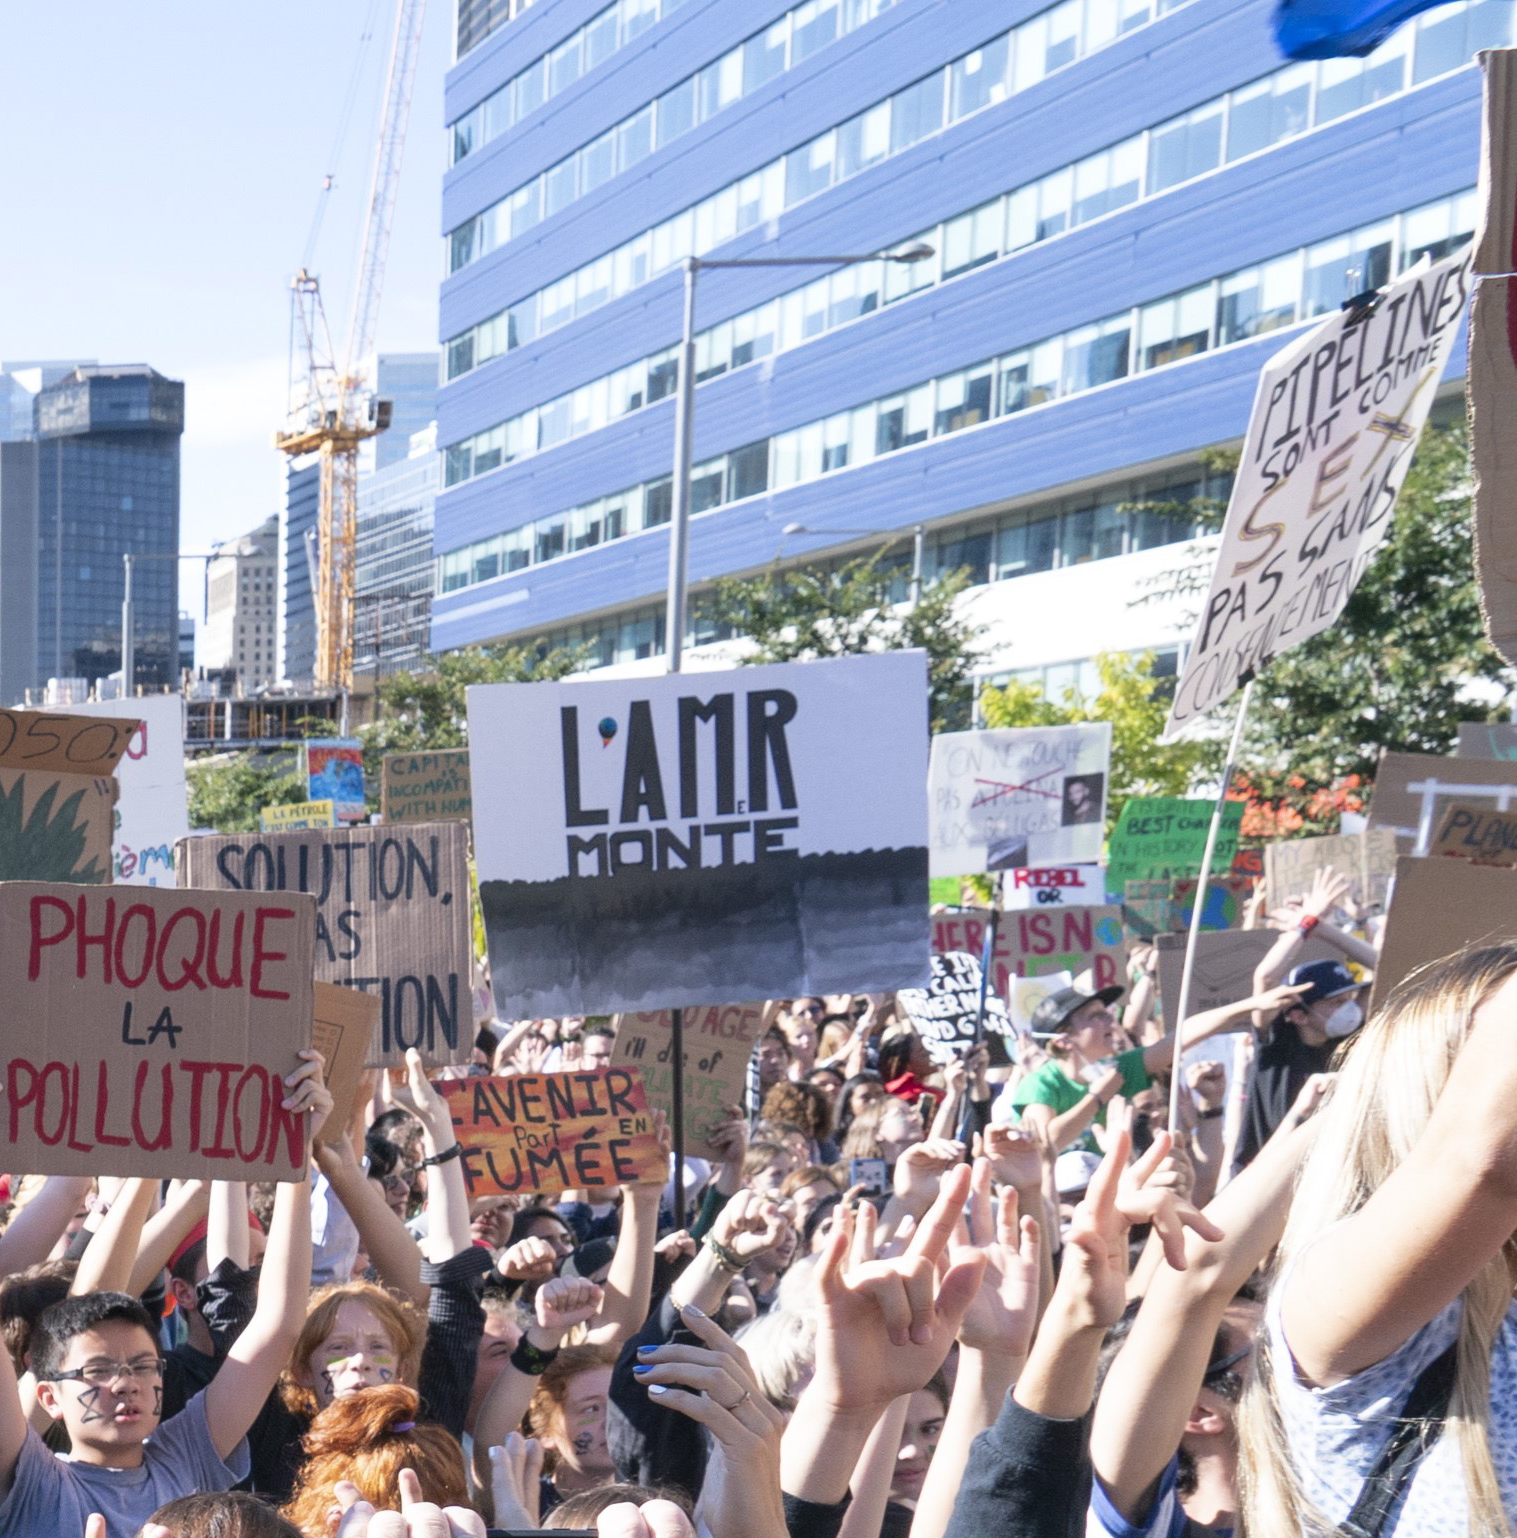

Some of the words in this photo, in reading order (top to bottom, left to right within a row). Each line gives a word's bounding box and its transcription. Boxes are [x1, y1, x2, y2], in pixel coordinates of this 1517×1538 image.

[1256, 253, 1471, 464] PIPELINES
[1261, 411, 1340, 492] SONT
[1358, 336, 1442, 414] COMME
[1232, 367, 1437, 578] SEX
[1199, 550, 1285, 654] PAS
[1299, 435, 1415, 580] SANS
[388, 801, 437, 820] WITH
[1126, 815, 1175, 836] BEST
[567, 817, 799, 879] MONTE
[1036, 889, 1063, 904] OR
[28, 894, 296, 1000] PHOQUE
[1019, 912, 1056, 955] IS
[121, 1000, 183, 1048] LA
[701, 1005, 759, 1042] AGE
[698, 1050, 724, 1074] of
[6, 1058, 304, 1169] POLLUTION
[619, 1117, 648, 1136] EN
[465, 1126, 640, 1194] FUMÉE
